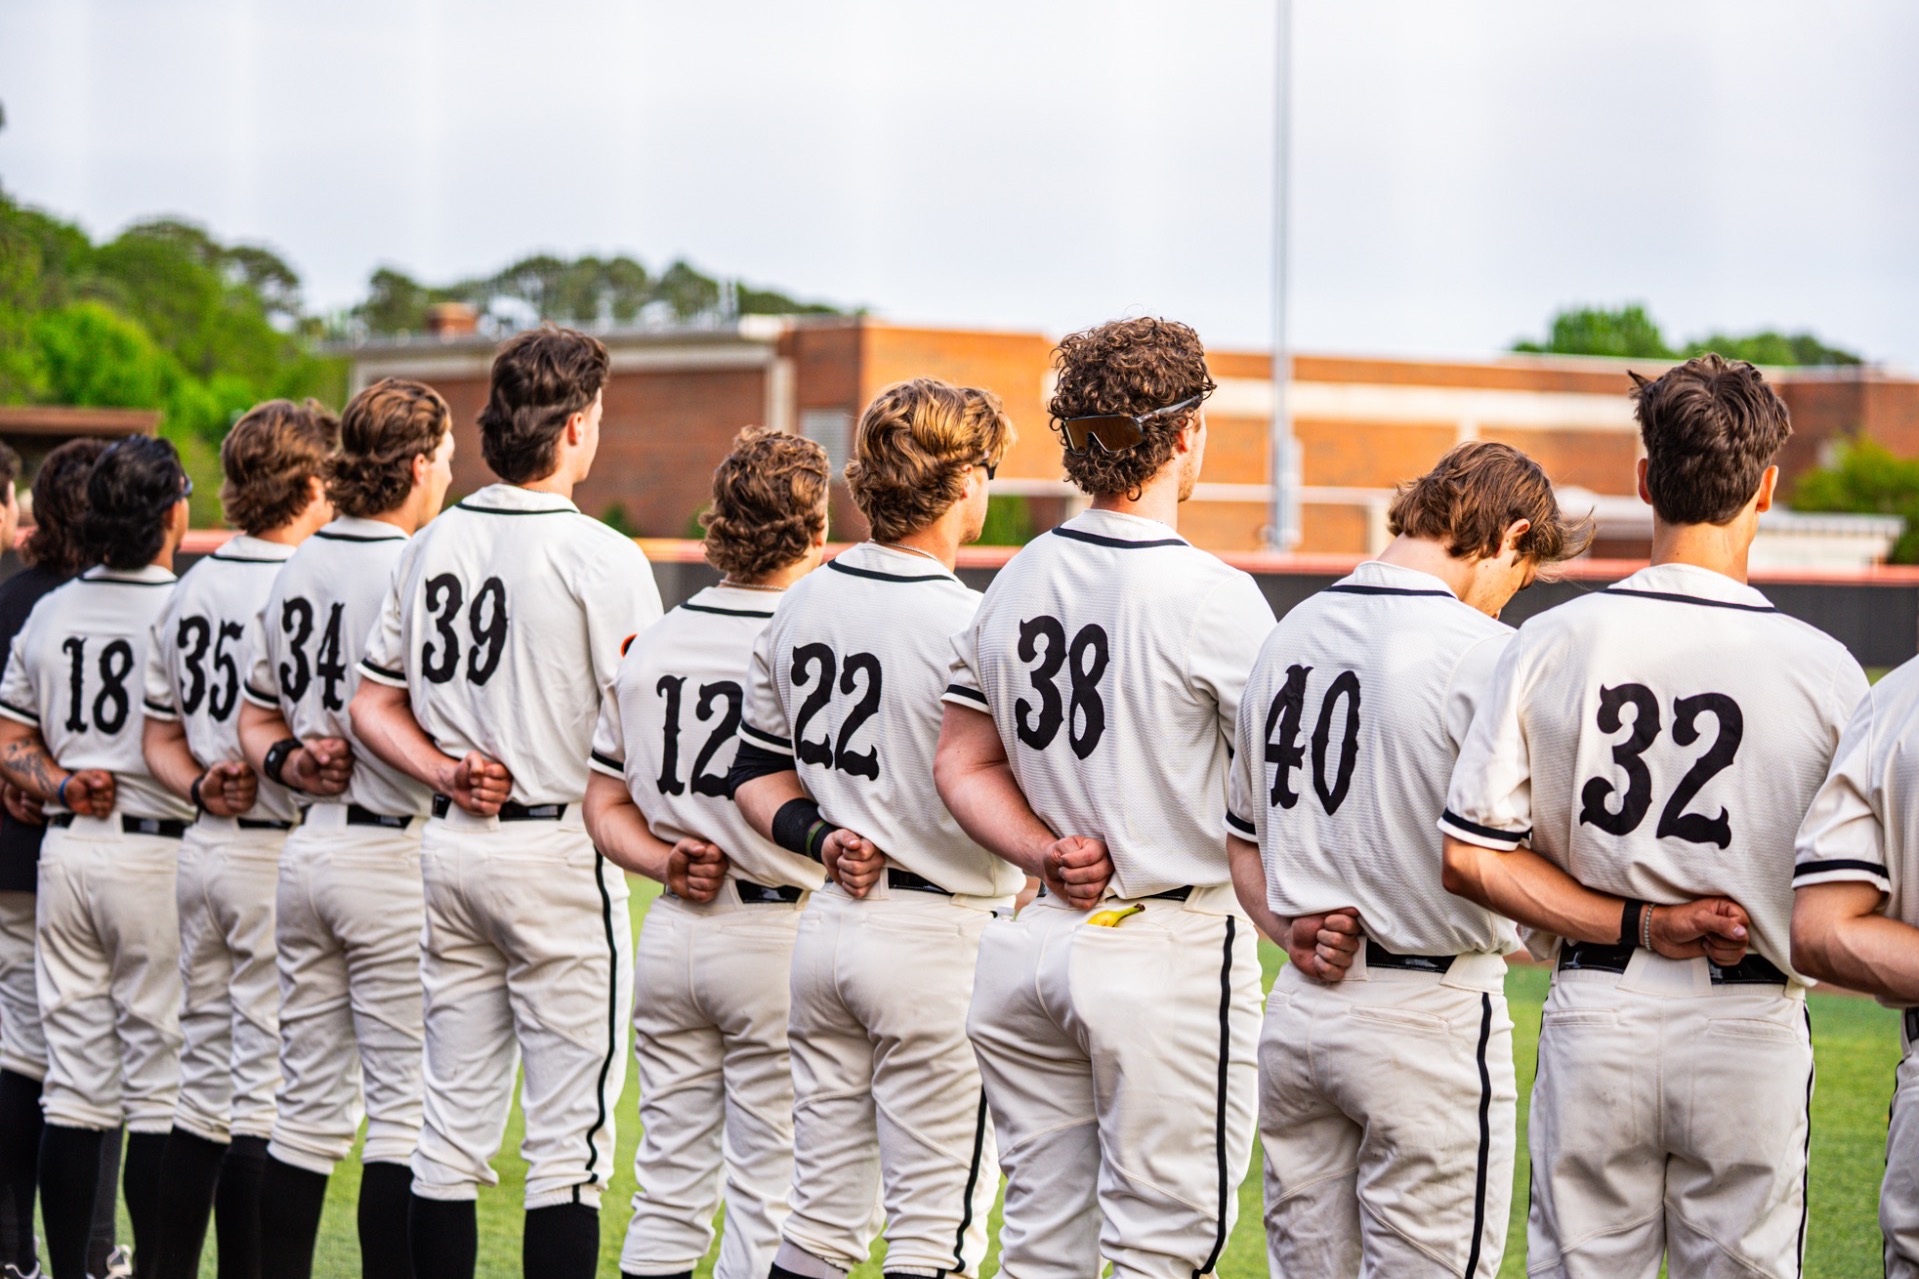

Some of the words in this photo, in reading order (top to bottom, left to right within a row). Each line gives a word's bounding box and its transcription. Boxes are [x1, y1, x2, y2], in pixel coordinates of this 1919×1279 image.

[62, 636, 135, 735] 18
[176, 616, 245, 723] 35
[279, 597, 347, 712] 34
[422, 572, 509, 687] 39
[1014, 615, 1111, 761] 38
[655, 674, 744, 801] 12
[791, 642, 883, 782] 22
[1263, 664, 1362, 817] 40
[1579, 683, 1744, 851] 32
